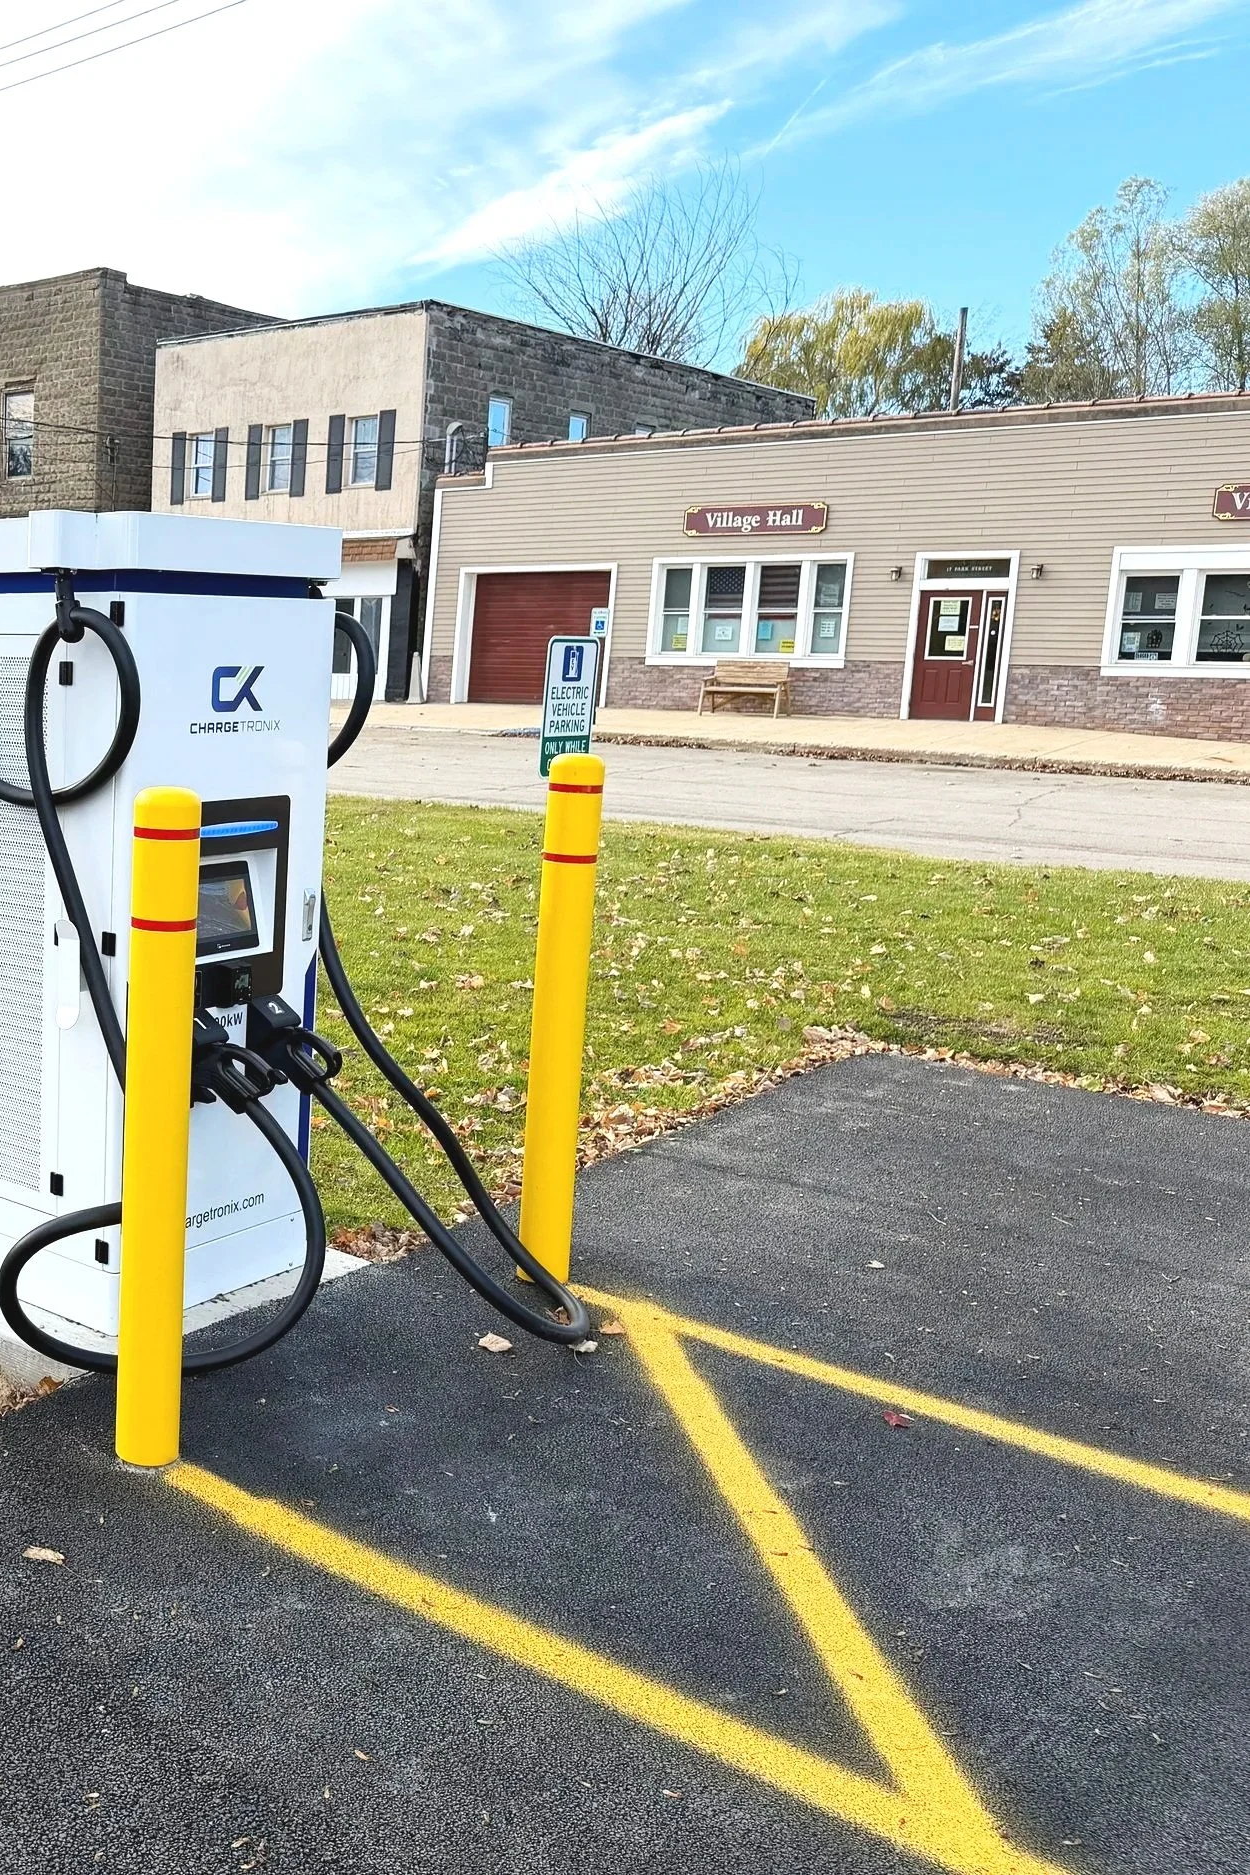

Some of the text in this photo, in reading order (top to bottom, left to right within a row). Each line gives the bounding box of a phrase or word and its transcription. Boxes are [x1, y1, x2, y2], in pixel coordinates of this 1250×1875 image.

[705, 508, 804, 533] Village Hall
[551, 686, 590, 700] ELECTRIC
[552, 702, 586, 717] VEHICLE
[190, 720, 280, 734] CHARGETRONIX
[549, 719, 585, 734] PARKING
[544, 739, 587, 755] ONLY WHILE
[268, 1001, 284, 1015] 2
[185, 1193, 264, 1229] argetronix.com
